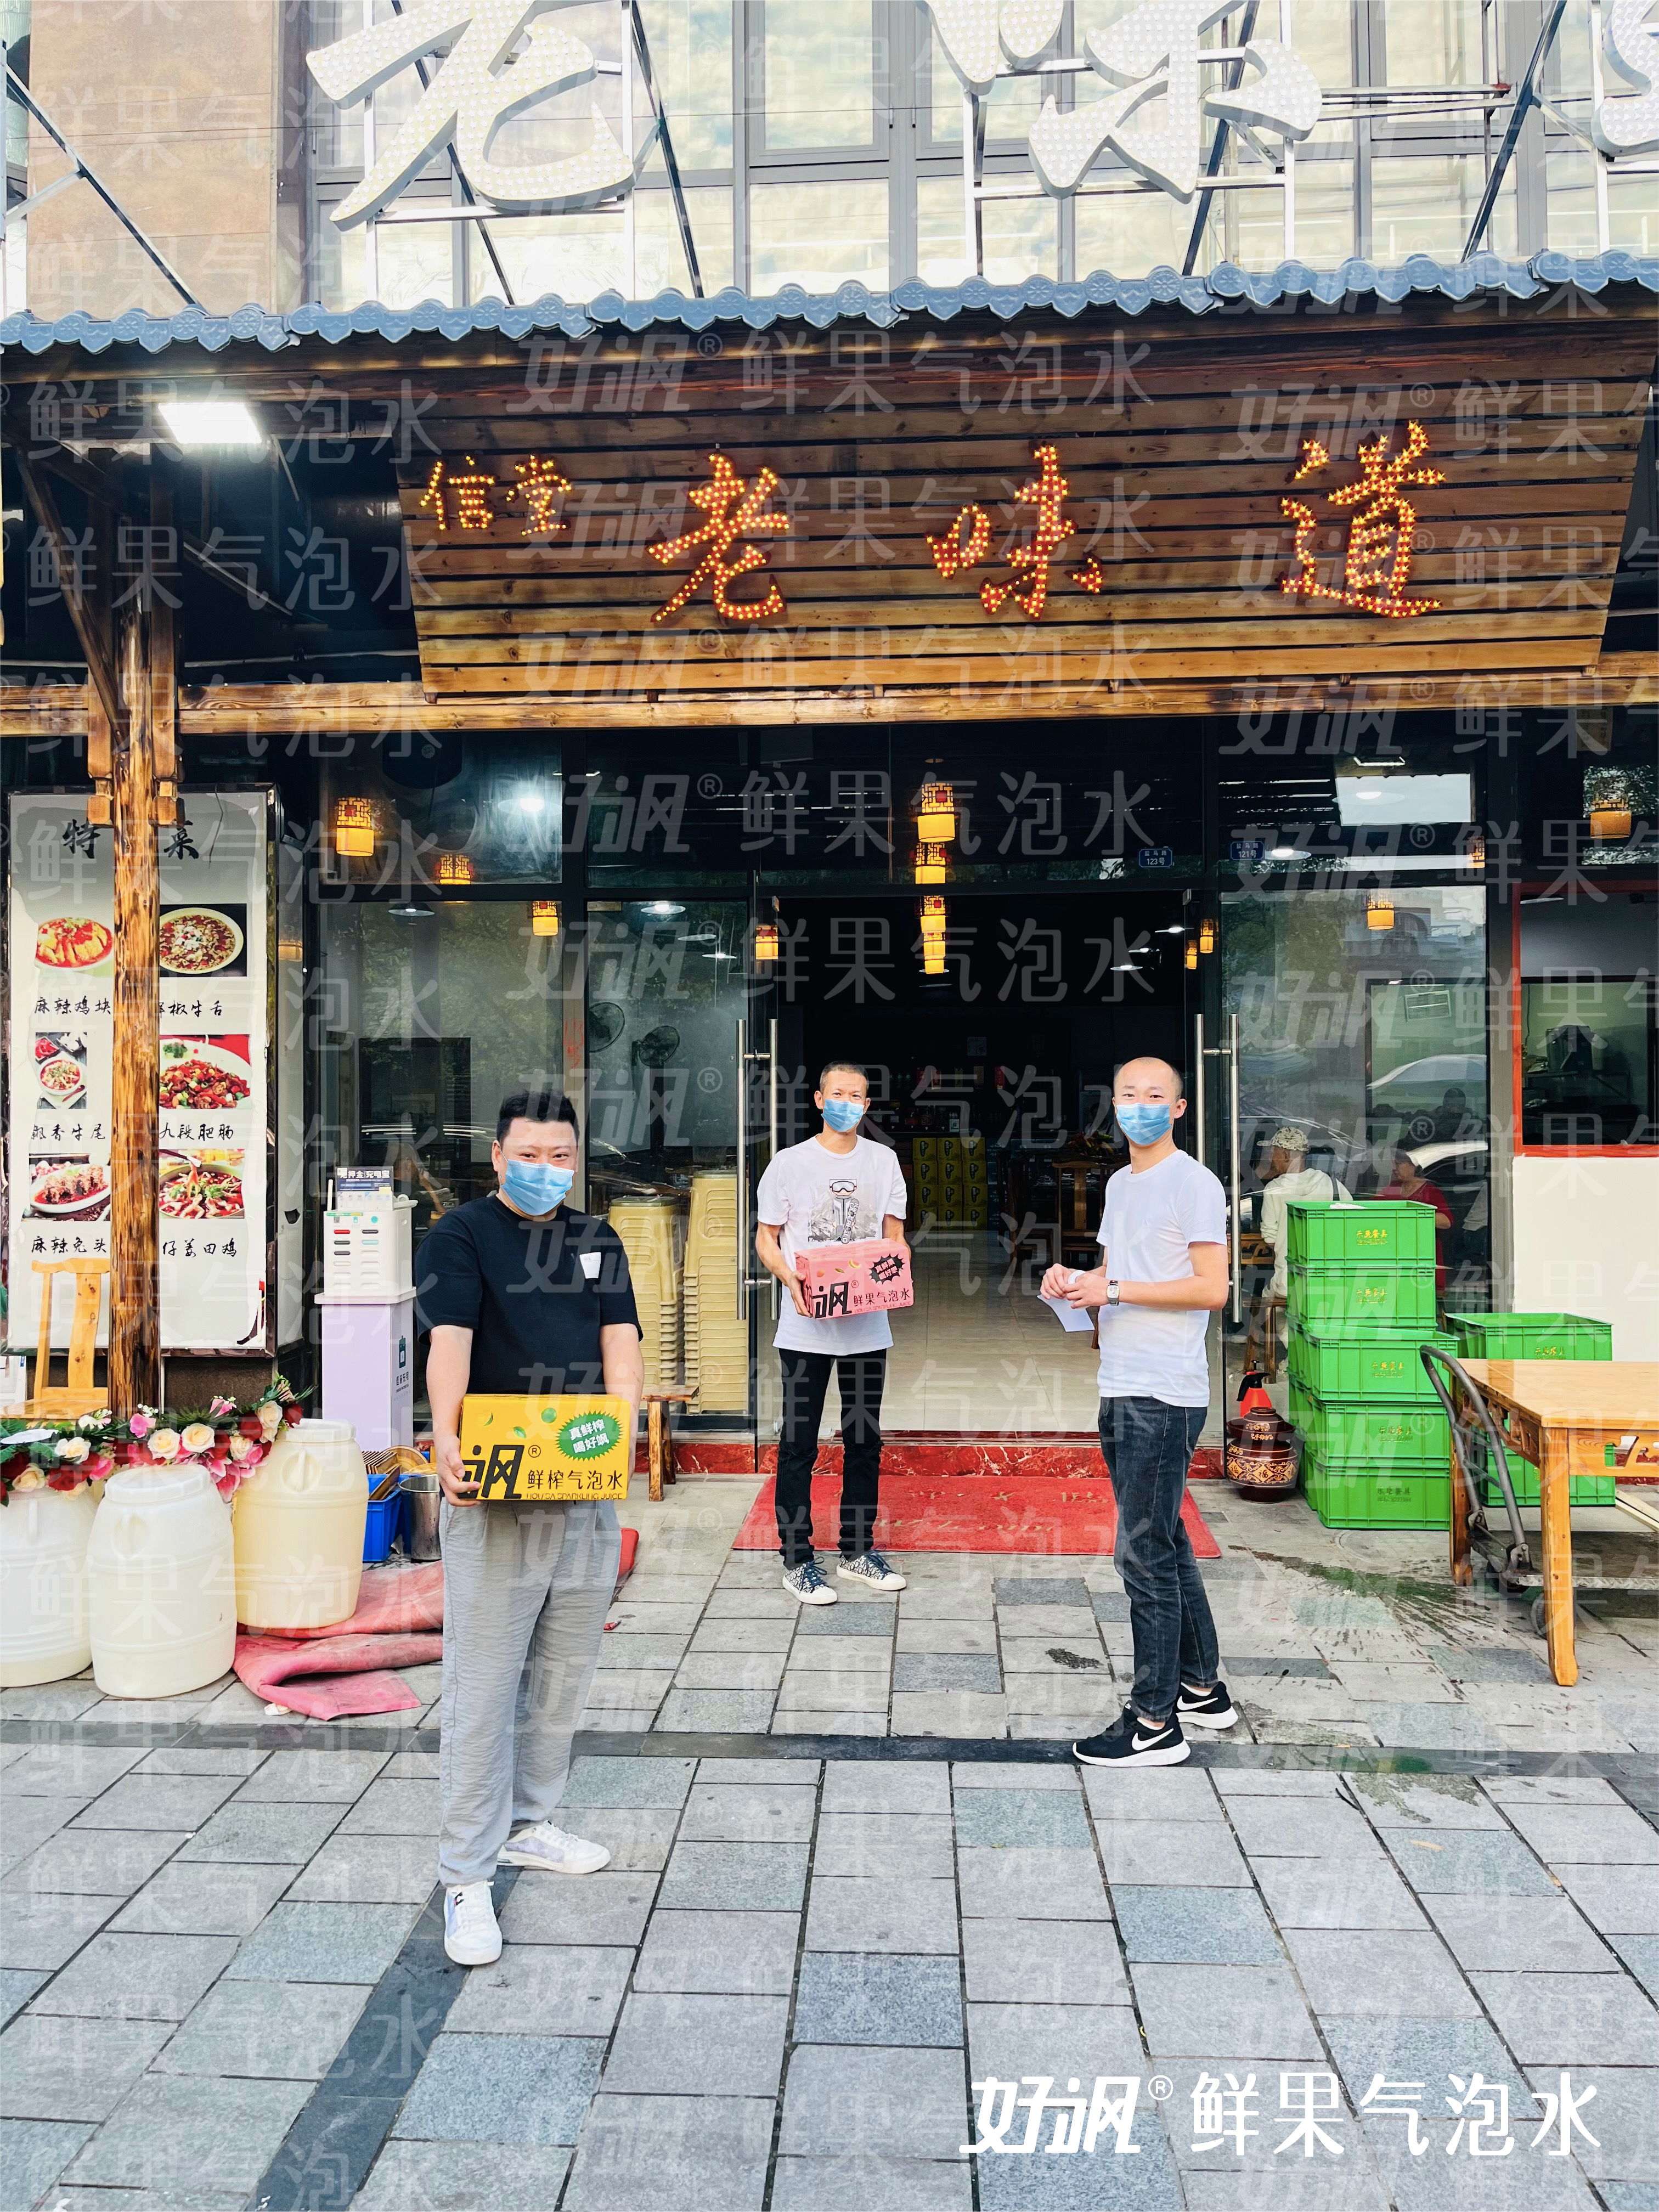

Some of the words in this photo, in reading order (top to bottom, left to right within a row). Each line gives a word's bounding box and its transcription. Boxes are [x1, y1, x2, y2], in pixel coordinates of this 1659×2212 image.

[420, 454, 572, 536] 信堂
[648, 420, 1447, 622] 老味道
[62, 819, 199, 860] 特菜
[1146, 857, 1165, 866] 123号
[34, 996, 111, 1015] 麻辣鸡块
[31, 1235, 107, 1254] 麻辣兔头
[853, 1288, 910, 1307] 鲜果气泡水
[568, 1419, 605, 1441] 真鲜榨
[527, 1470, 623, 1490] 鲜榨气泡水
